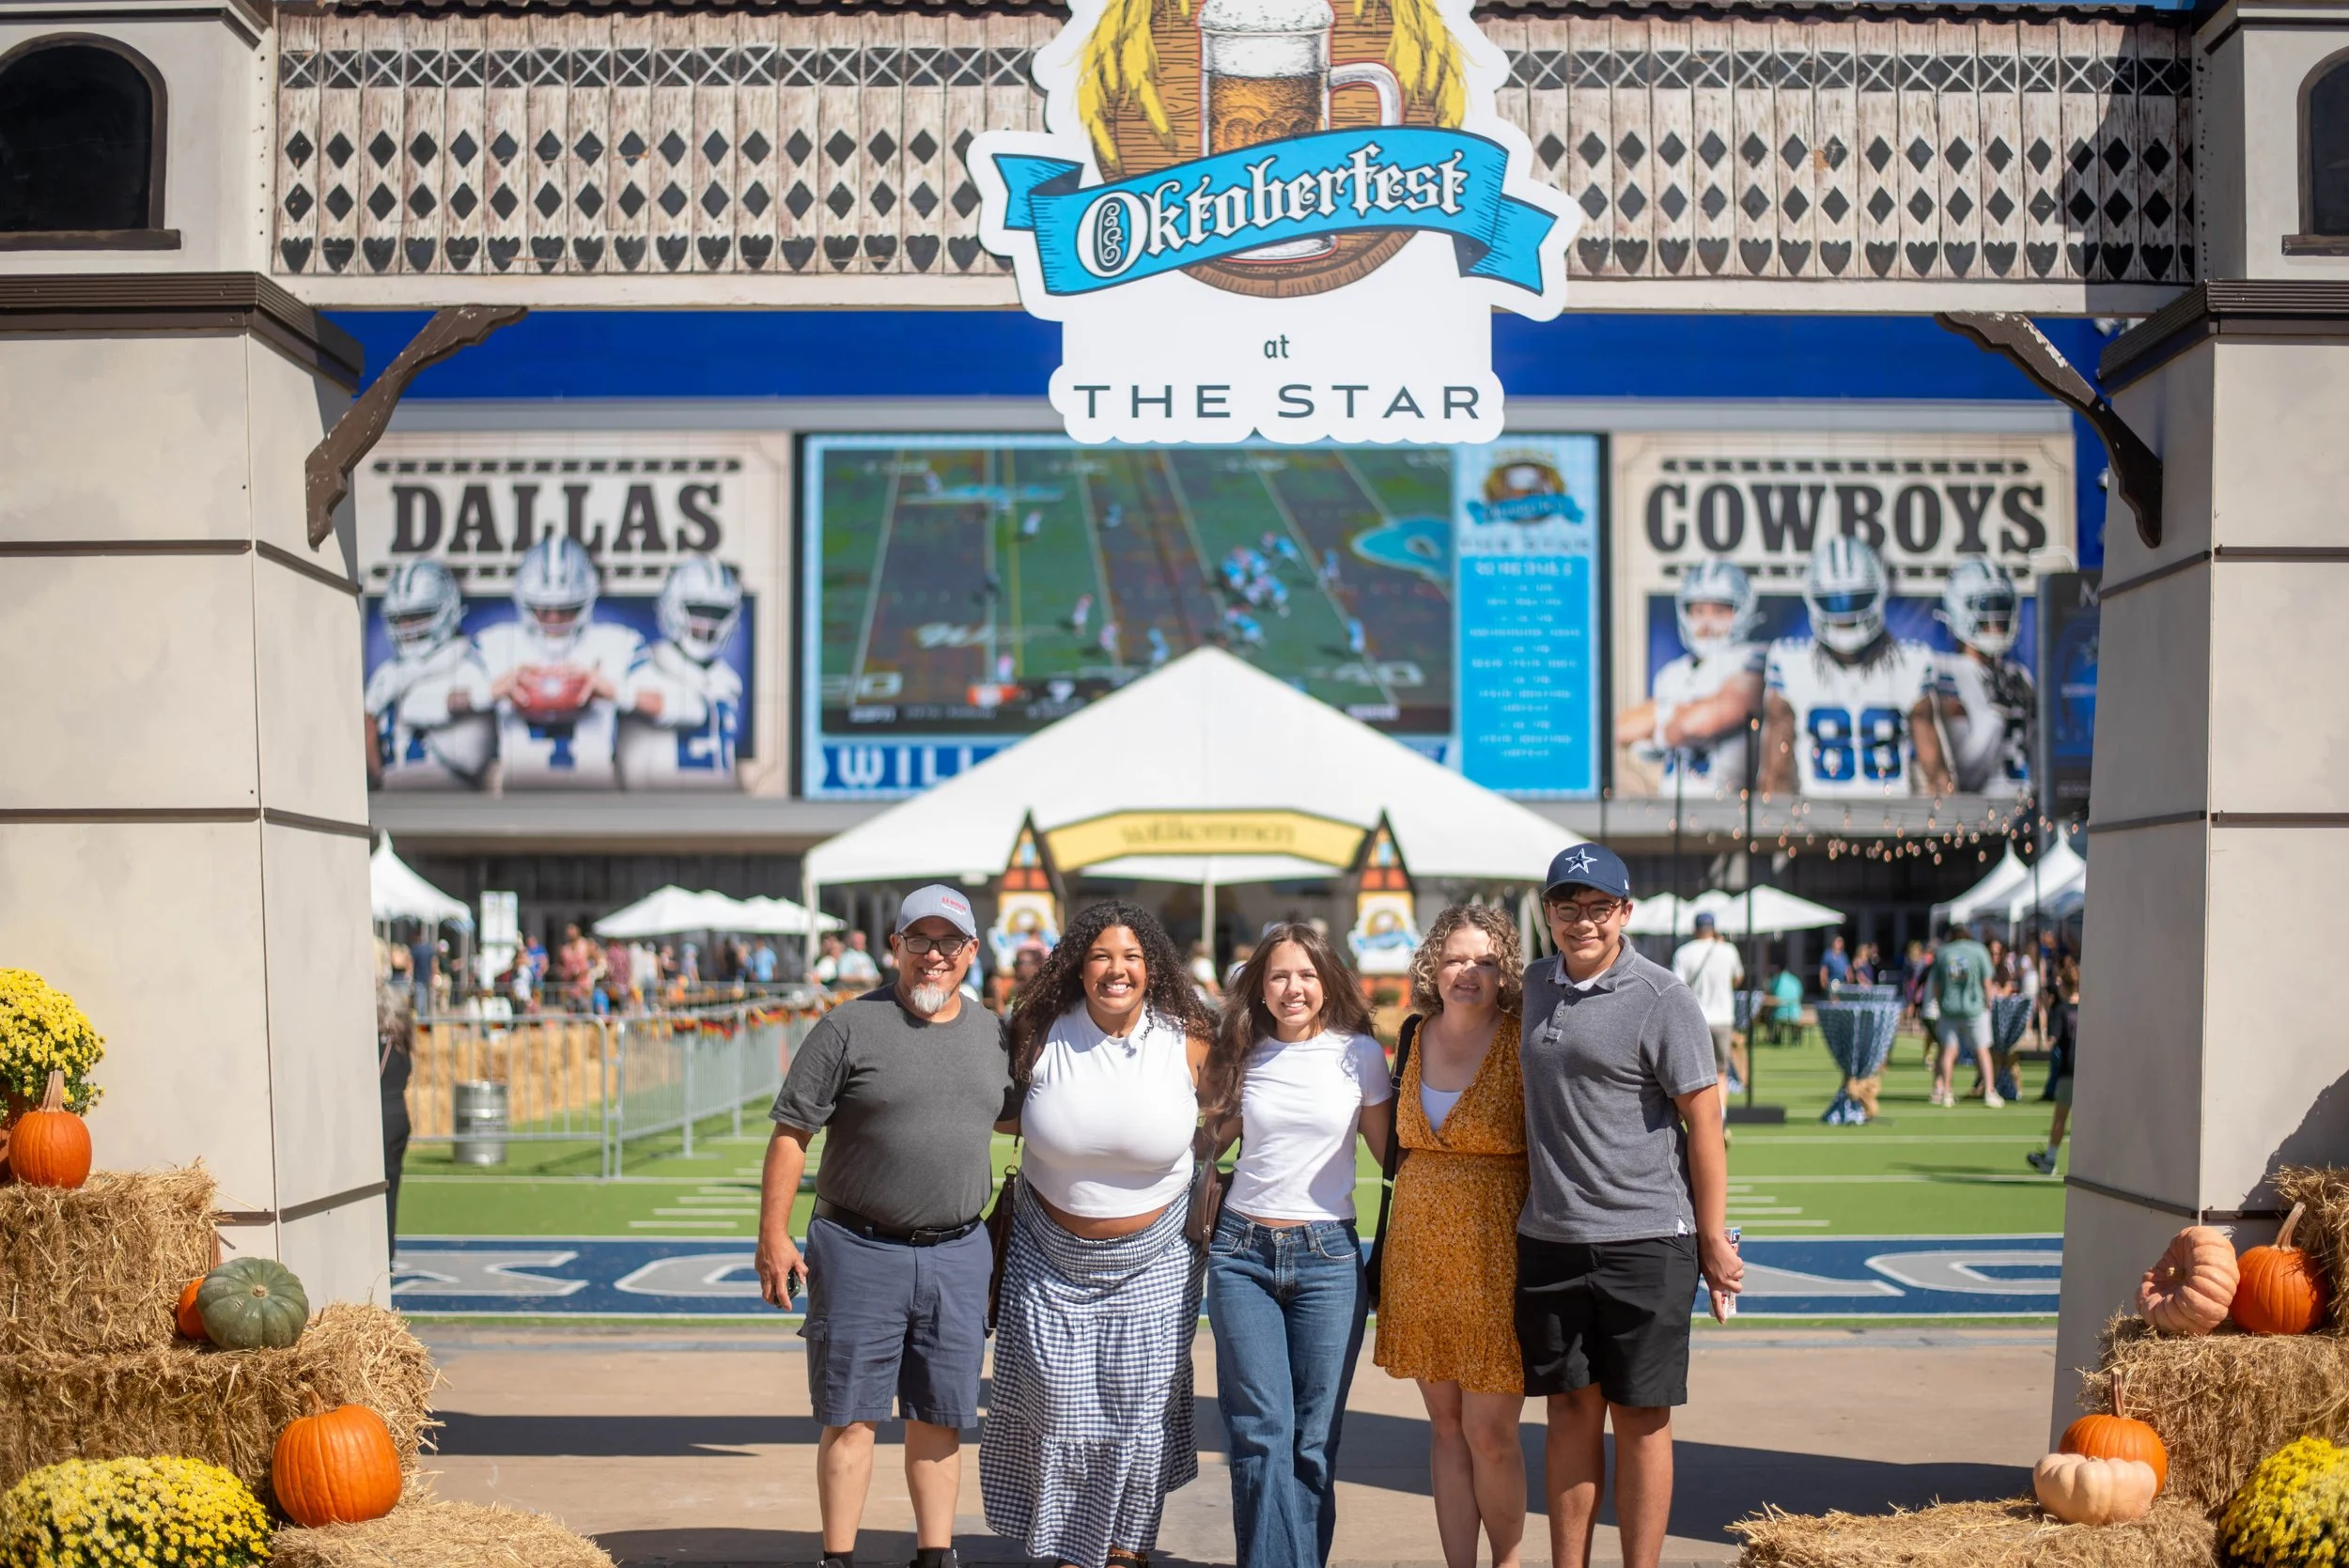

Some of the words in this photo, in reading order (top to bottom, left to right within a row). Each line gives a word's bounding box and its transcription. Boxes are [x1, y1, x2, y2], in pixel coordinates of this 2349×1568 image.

[1076, 142, 1467, 279] Oktoberfest
[1263, 334, 1290, 359] at
[1073, 384, 1232, 419] THE
[1277, 383, 1480, 419] STAR
[390, 482, 723, 553] DALLAS
[1645, 481, 2047, 554] COWBOYS
[1808, 707, 1904, 781] 88
